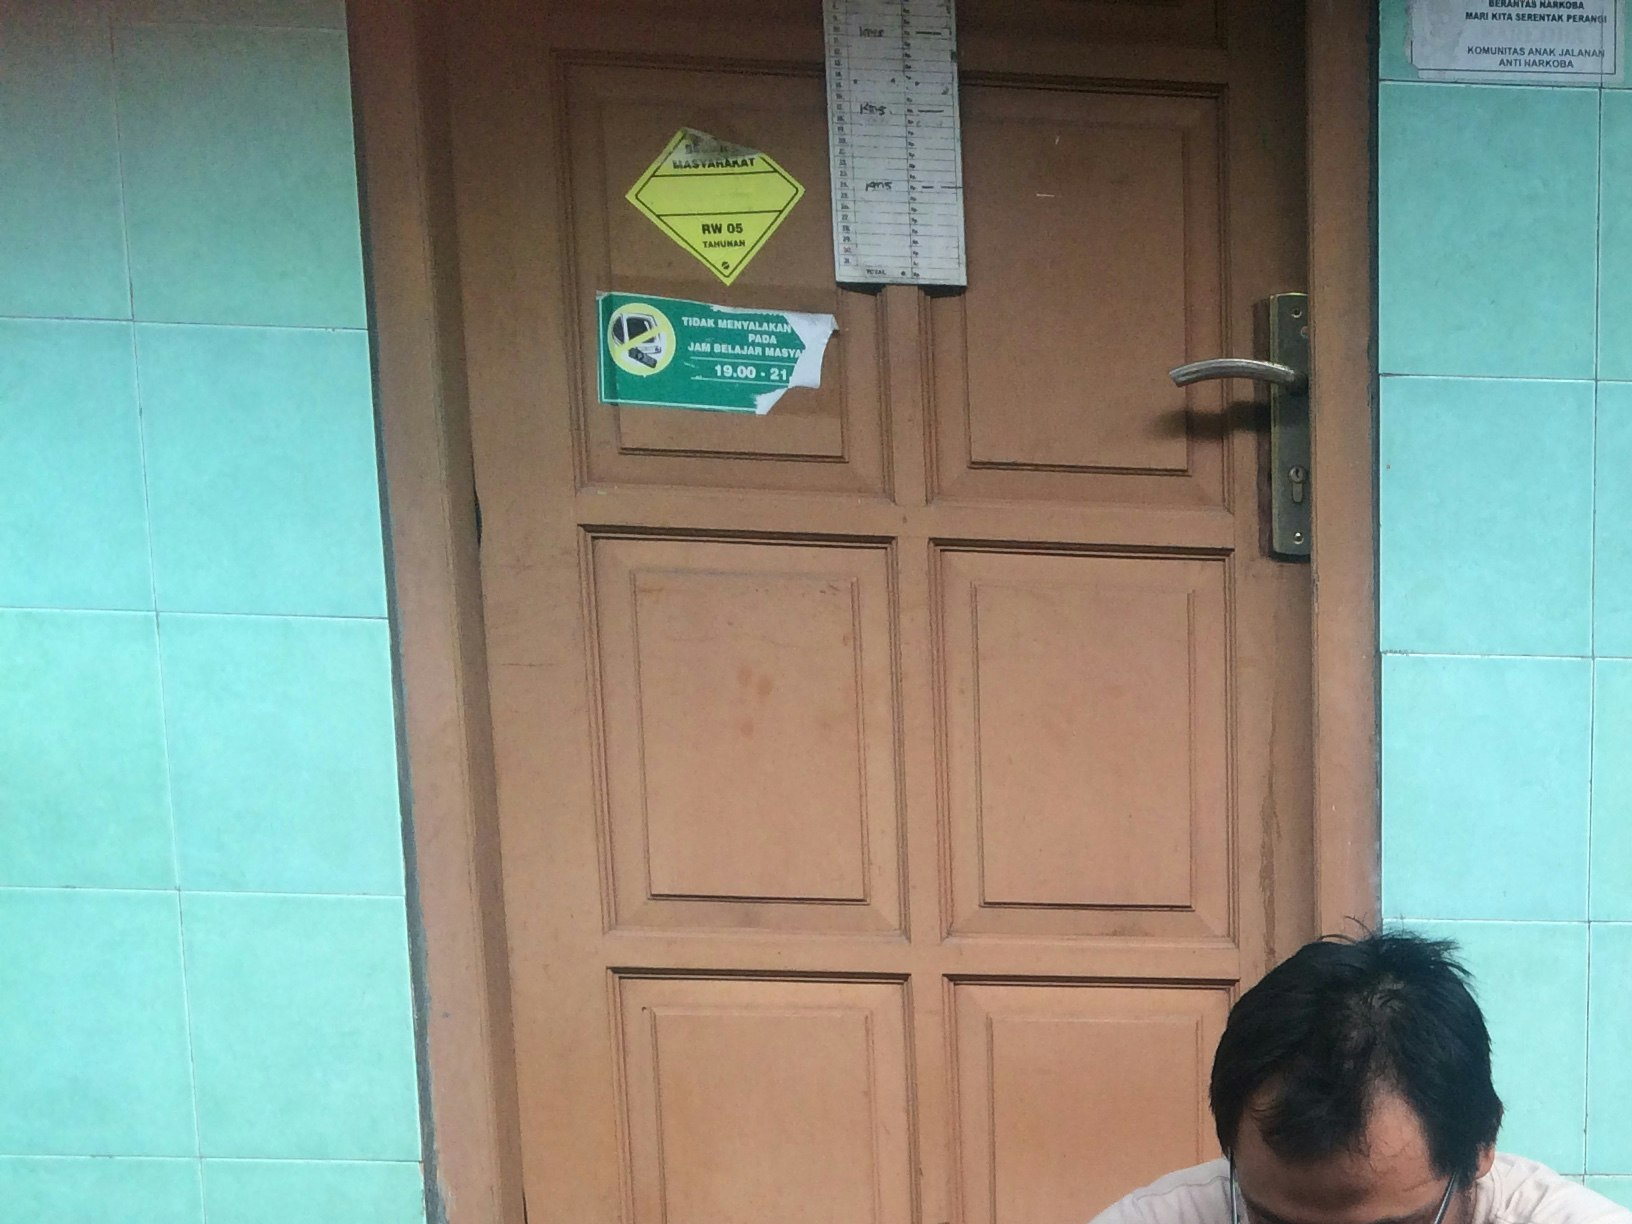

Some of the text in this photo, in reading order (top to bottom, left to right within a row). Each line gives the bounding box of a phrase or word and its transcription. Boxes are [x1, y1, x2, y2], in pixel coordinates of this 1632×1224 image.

[1488, 0, 1584, 10] BERANTAS NARKOBA
[1465, 12, 1489, 20] MARI
[1491, 12, 1513, 21] KITA
[1515, 13, 1564, 23] SERENTAK
[1467, 46, 1605, 58] KOMUNITAS ANAK JALANAN
[1498, 58, 1574, 68] ANTI NARKOBA
[672, 157, 756, 169] MASYARAKAT
[701, 223, 744, 235] RW 05
[681, 316, 792, 333] TIDAK MENYALAKAN
[748, 333, 777, 344] PADA
[687, 342, 711, 353] JAM
[713, 343, 763, 356] BELAJAR
[714, 364, 756, 379] 19.00
